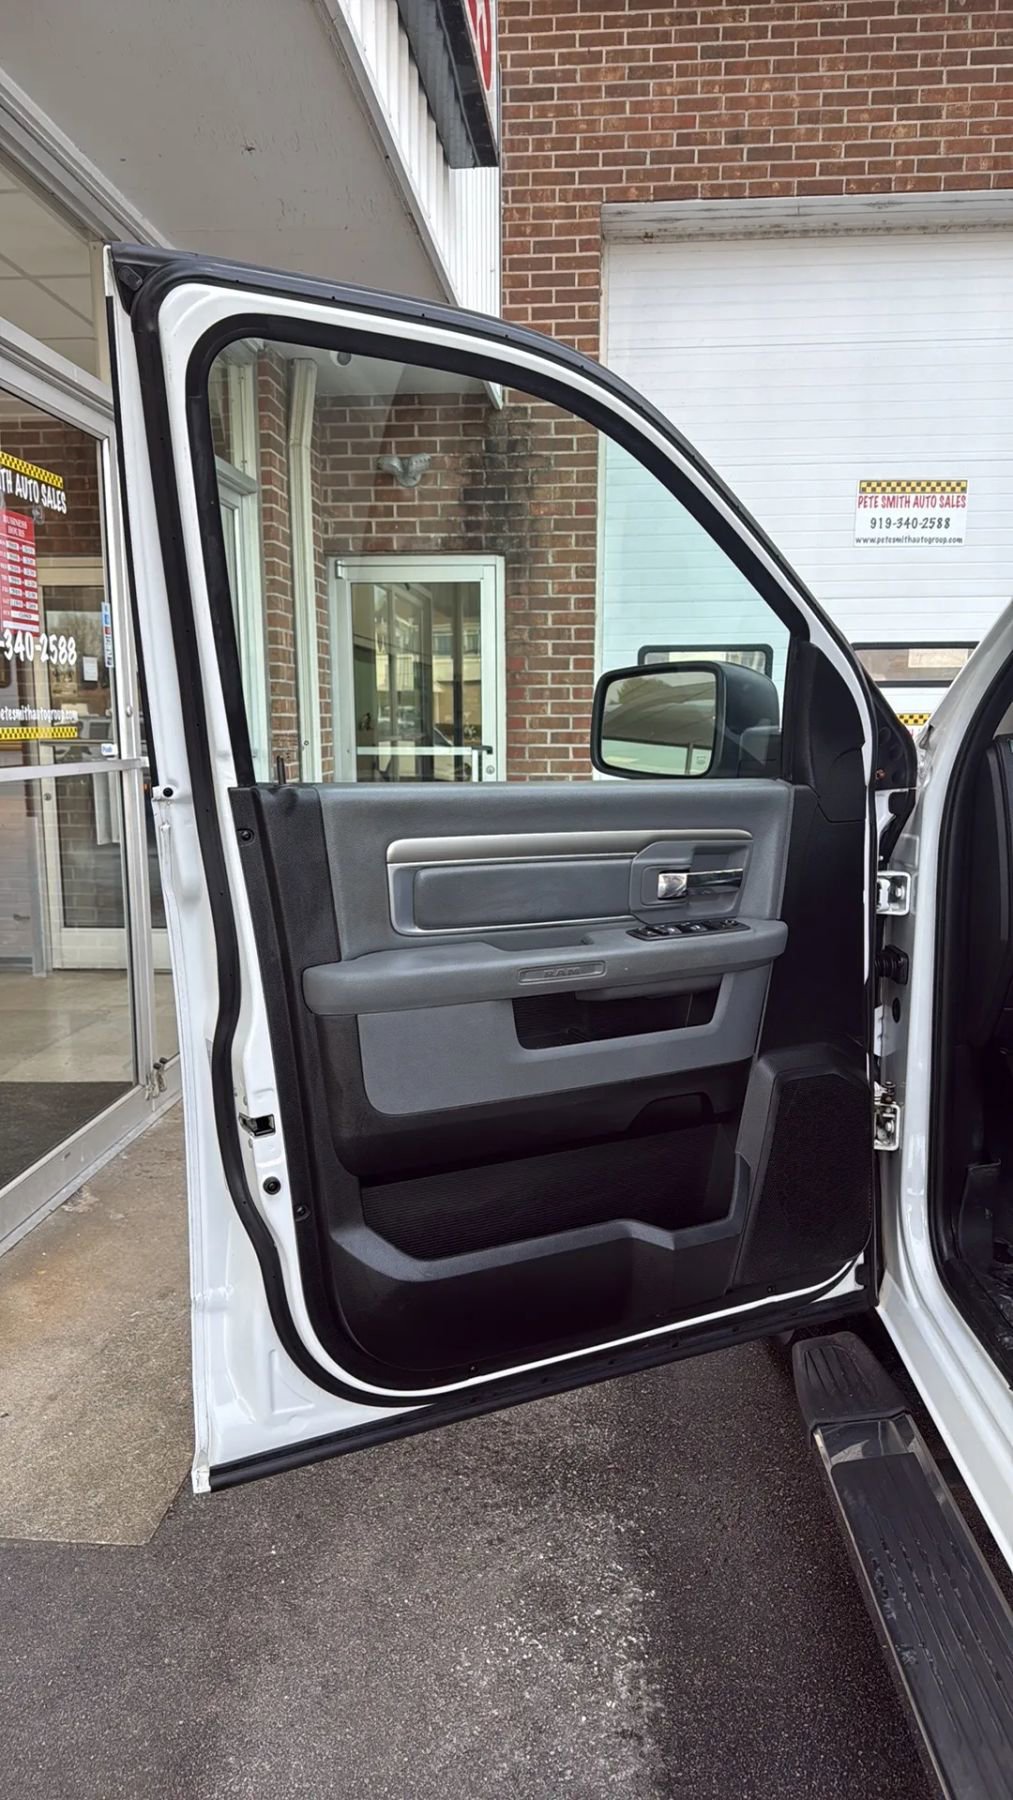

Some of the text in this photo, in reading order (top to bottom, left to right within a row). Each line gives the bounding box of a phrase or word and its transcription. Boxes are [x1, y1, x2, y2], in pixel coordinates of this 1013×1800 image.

[15, 473, 40, 504] AUTO
[41, 483, 67, 514] SALES
[858, 495, 966, 509] PETE SMITH AUTO SALES
[870, 517, 951, 529] 919-340-2588
[855, 535, 963, 545] www.petesmithautogroup.com
[543, 966, 581, 978] RAM
